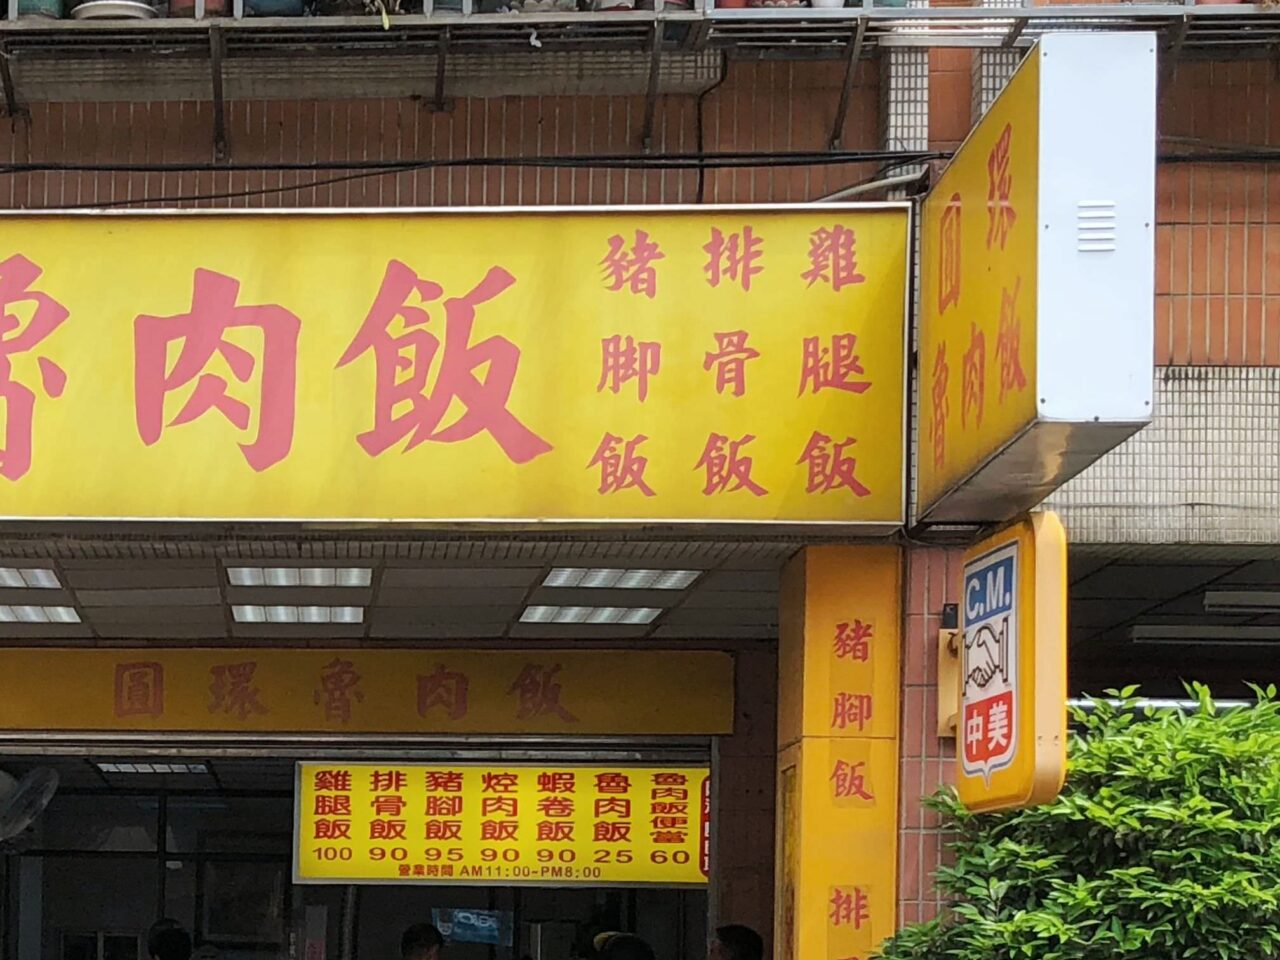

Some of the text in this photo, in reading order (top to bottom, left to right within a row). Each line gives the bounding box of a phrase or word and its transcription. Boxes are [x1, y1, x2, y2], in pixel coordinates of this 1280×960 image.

[693, 225, 769, 497] 排骨飯
[796, 224, 872, 497] 雞腿飯
[114, 657, 581, 724] 圓環魯肉飯
[830, 618, 874, 801] 豬腳飯
[967, 700, 1009, 755] 中美
[313, 770, 352, 840] 雞腿飯
[369, 770, 407, 841] 排骨飯
[424, 771, 463, 841] 豬腳飯
[536, 772, 576, 842] 蝦卷飯
[592, 772, 632, 843] 魯肉飯
[649, 773, 688, 844] 魯肉飯便當
[313, 847, 690, 864] 100 90 95 90 90 25 60
[398, 864, 454, 877] 營業時間
